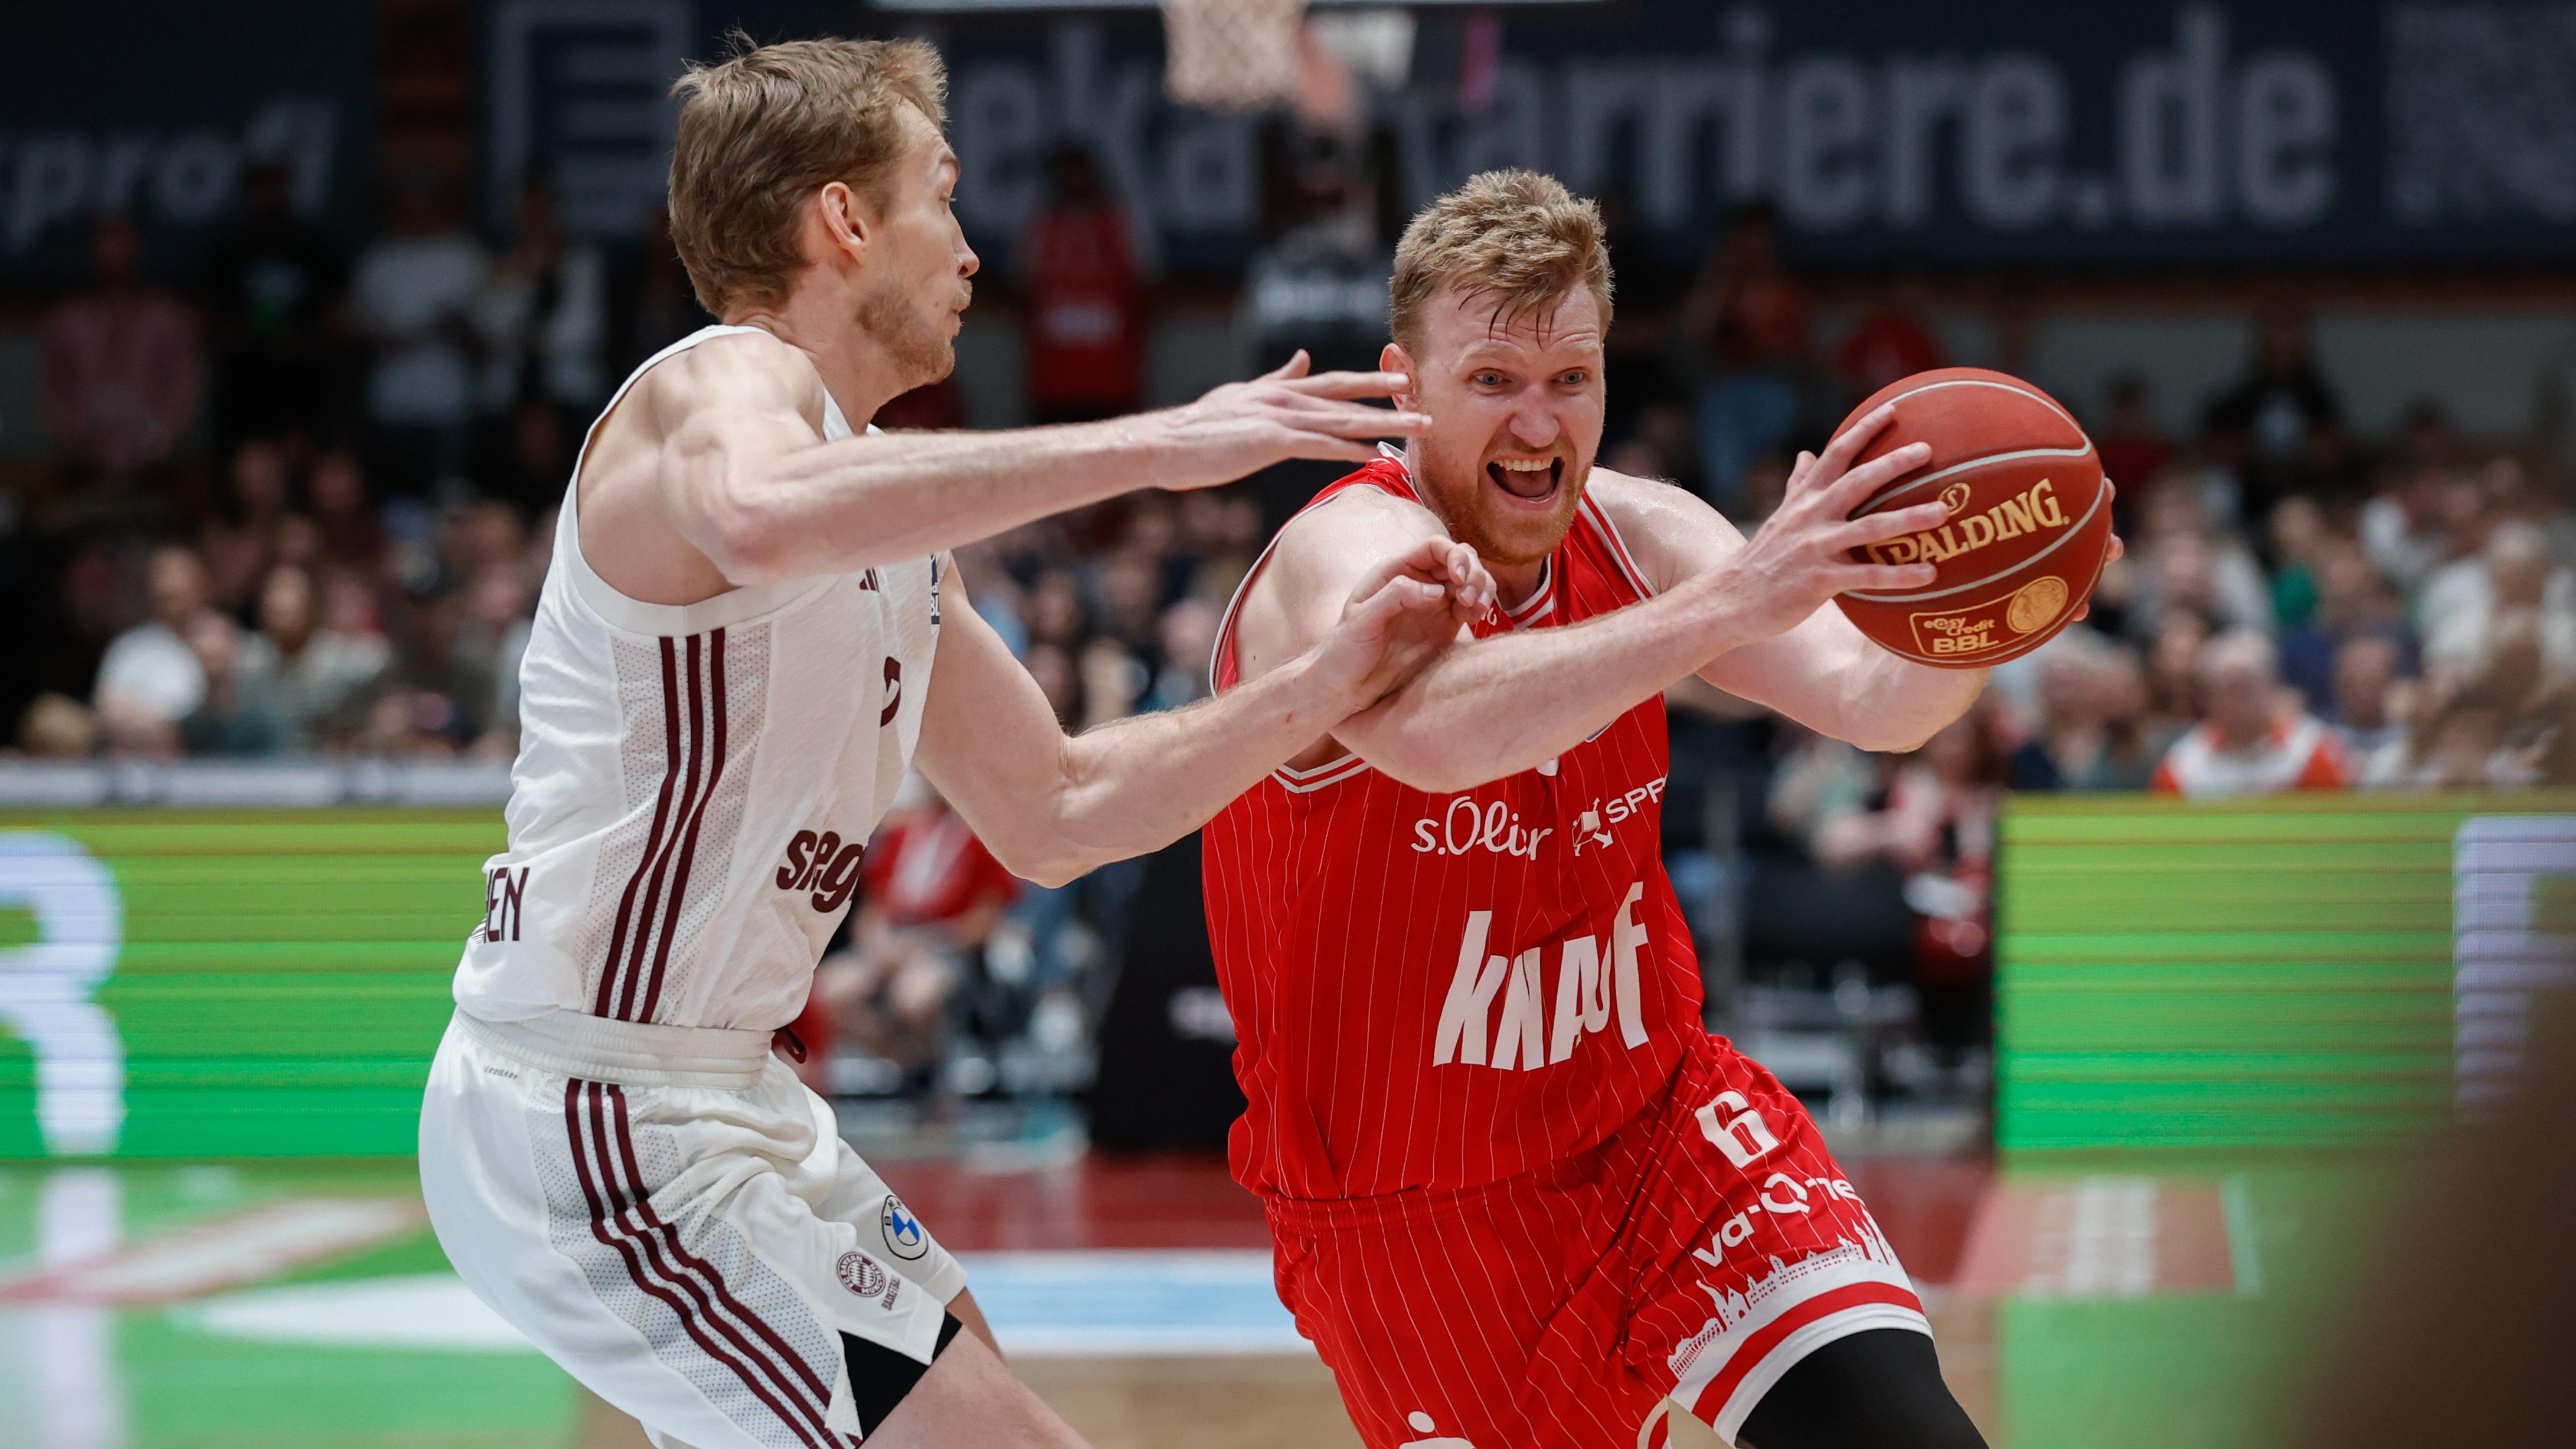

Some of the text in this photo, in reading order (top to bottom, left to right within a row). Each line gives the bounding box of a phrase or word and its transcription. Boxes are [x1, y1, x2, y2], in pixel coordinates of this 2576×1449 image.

[1865, 477, 2071, 567] PALDING
[1933, 632, 1999, 653] BBL
[1695, 1091, 1780, 1169] 6
